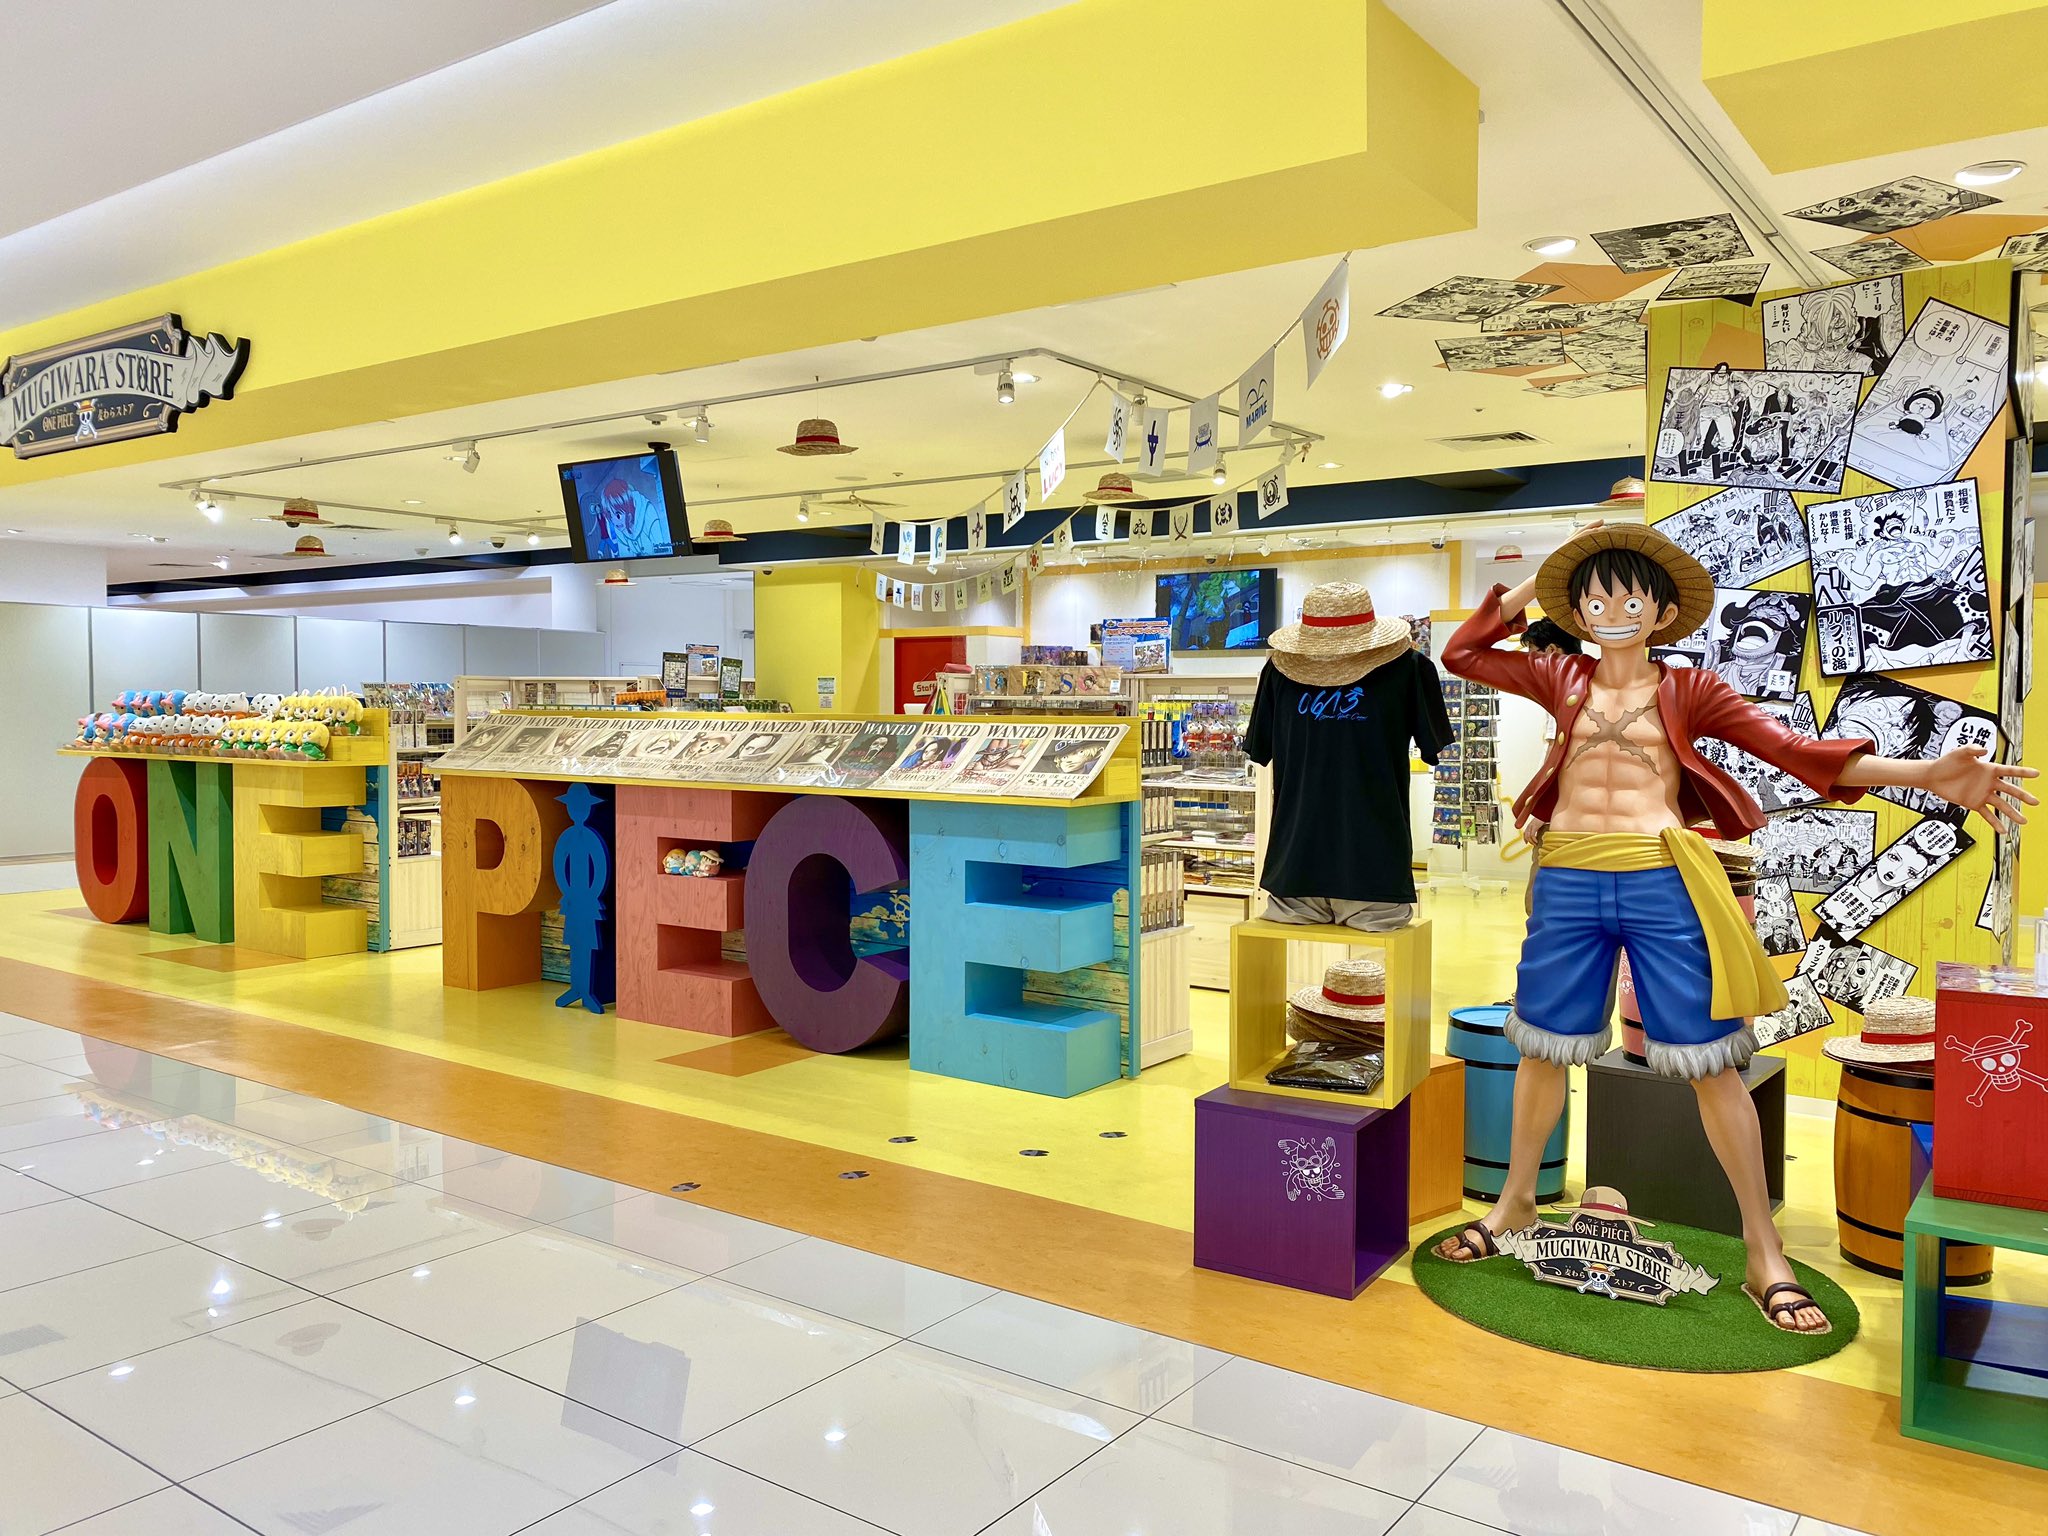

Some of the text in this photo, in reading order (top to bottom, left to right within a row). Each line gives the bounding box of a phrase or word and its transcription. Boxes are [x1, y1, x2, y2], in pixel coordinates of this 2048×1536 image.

[12, 351, 174, 431] MUGIWARA STORE
[1245, 399, 1268, 430] MARINE
[42, 412, 74, 432] ONE PIECE
[654, 719, 700, 731] WANTED
[701, 720, 750, 732] WANTED
[750, 721, 800, 733] WANTED
[809, 722, 863, 734] WANTED
[864, 722, 917, 736] WANTED
[922, 723, 981, 737] WANTED
[987, 725, 1049, 739] WANTED
[1053, 726, 1120, 740] WANTED
[74, 756, 374, 960] ONE
[1575, 1221, 1630, 1242] ONE PIECE
[1535, 1238, 1672, 1285] MUGIWARA STORE
